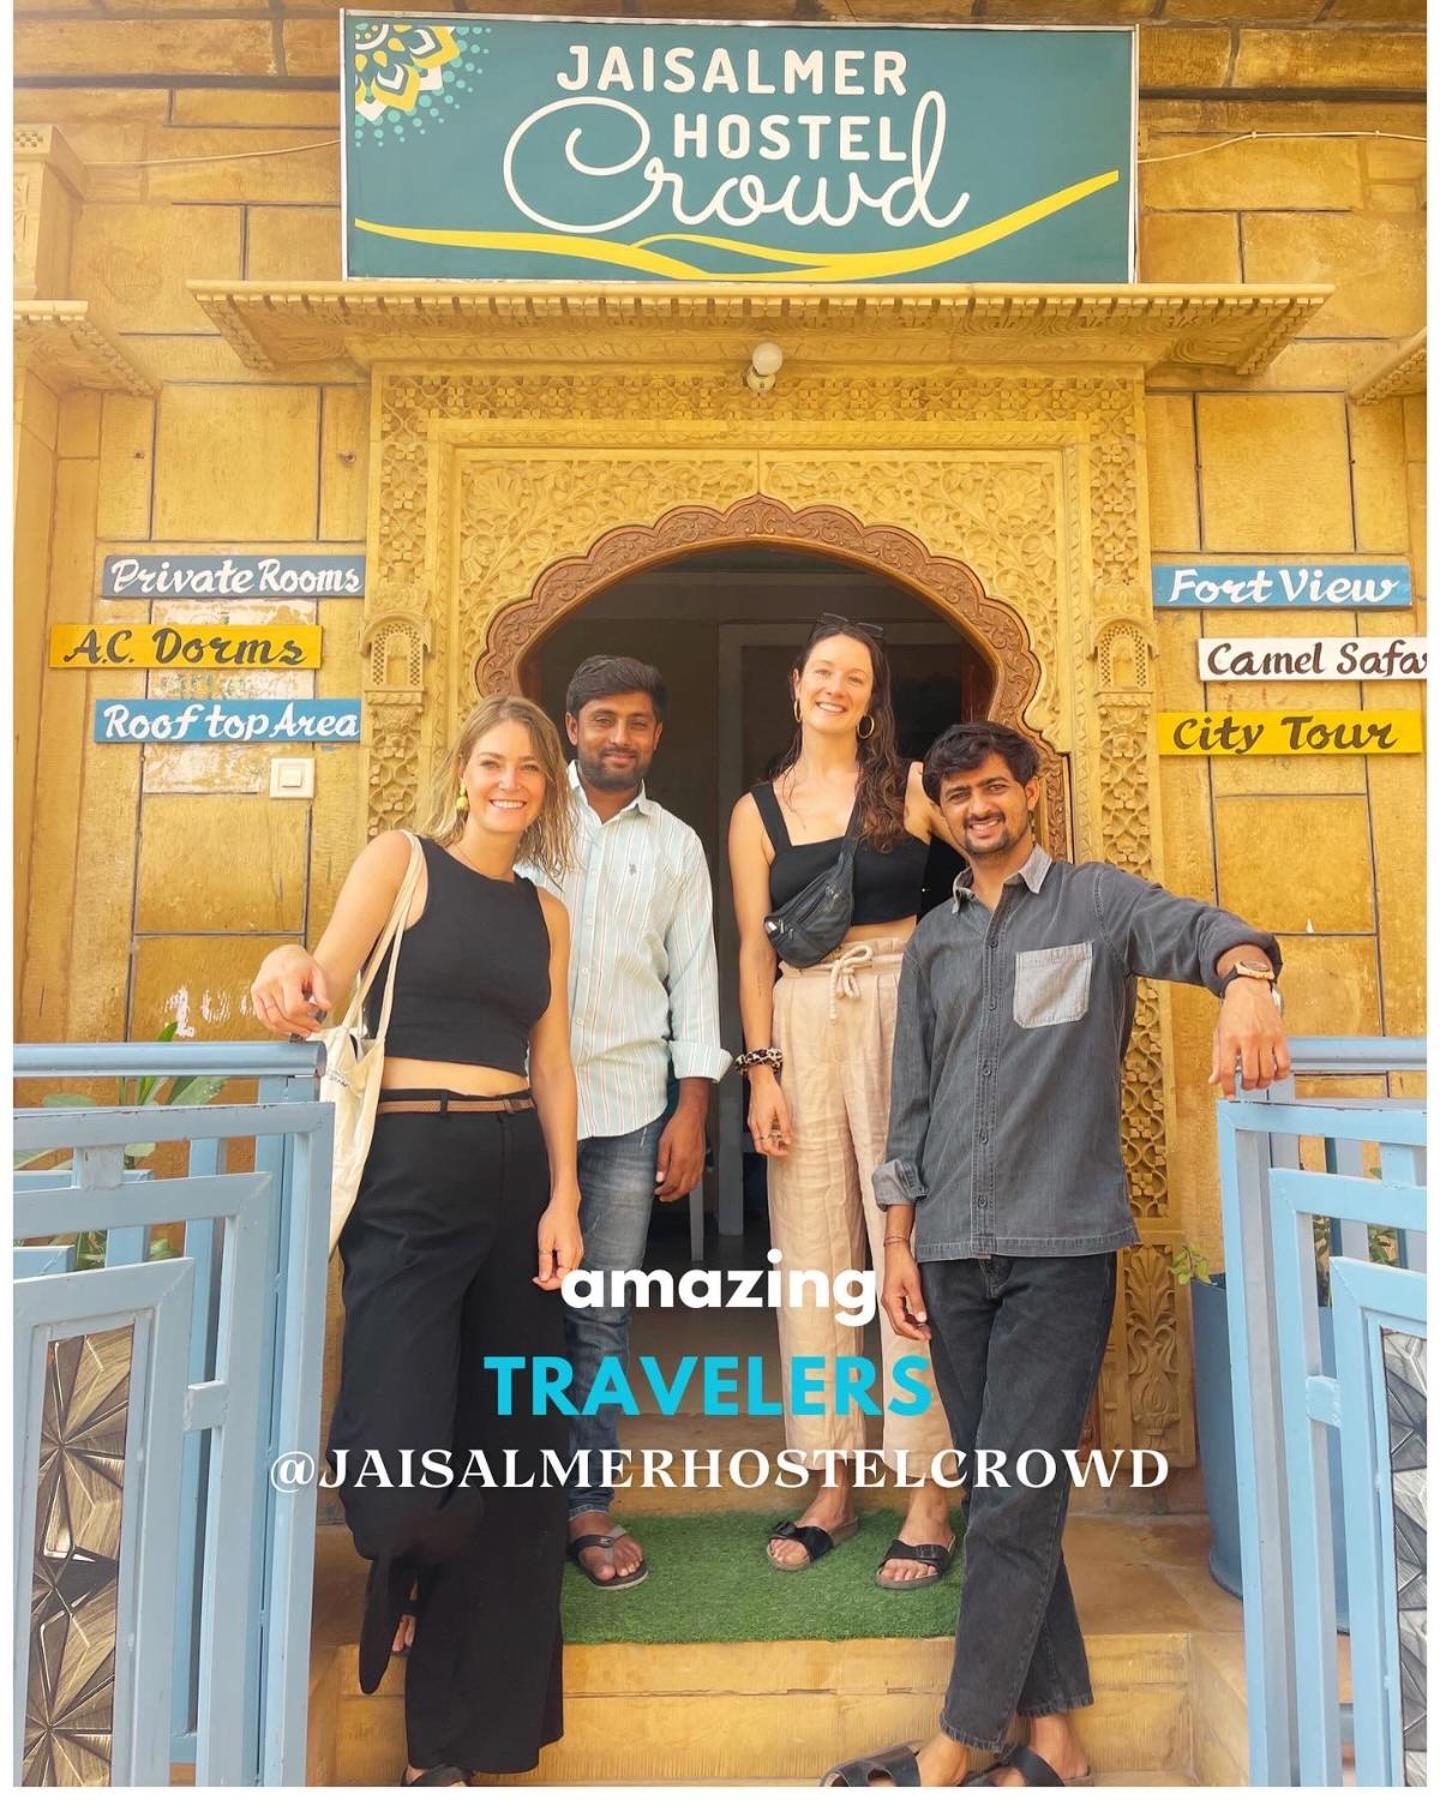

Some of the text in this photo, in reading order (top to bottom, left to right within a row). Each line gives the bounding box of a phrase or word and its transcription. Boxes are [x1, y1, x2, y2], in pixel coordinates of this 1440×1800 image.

[557, 45, 908, 97] JAISALMER
[673, 113, 908, 161] HOSTEL
[503, 90, 970, 233] Crowd
[111, 558, 362, 594] Private Rooms
[1168, 568, 1399, 603] Fort View
[63, 627, 308, 666] A.C. Dorms
[1207, 642, 1326, 676] Camel
[269, 702, 360, 739] Area
[1173, 715, 1398, 754] City Tour
